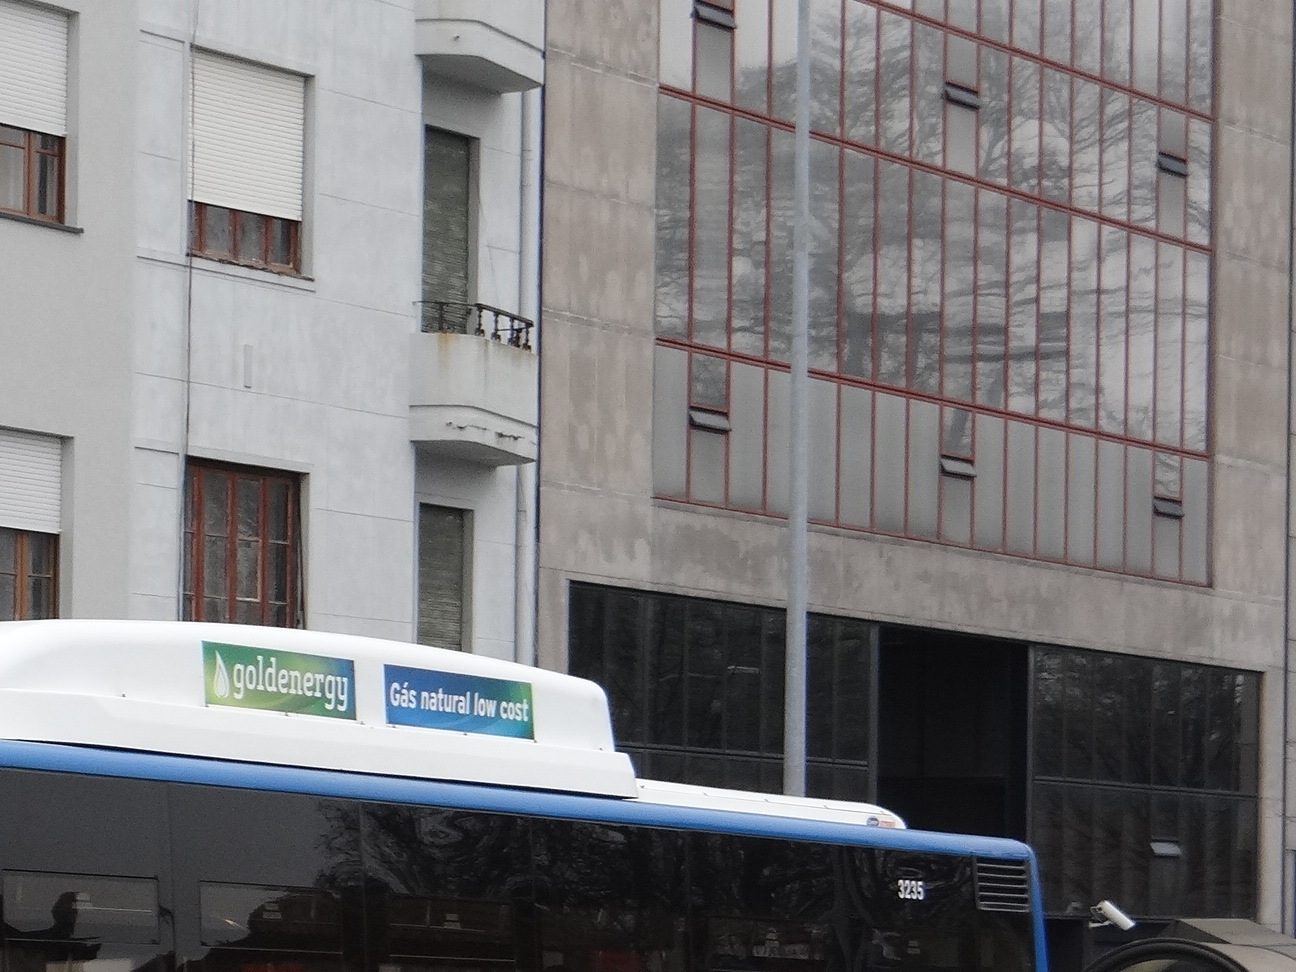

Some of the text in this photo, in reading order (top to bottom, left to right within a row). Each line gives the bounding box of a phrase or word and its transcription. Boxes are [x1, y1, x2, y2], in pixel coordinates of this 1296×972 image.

[233, 655, 349, 712] goldenergy
[389, 682, 529, 722] Gás natural low cost
[897, 879, 924, 900] 3235
